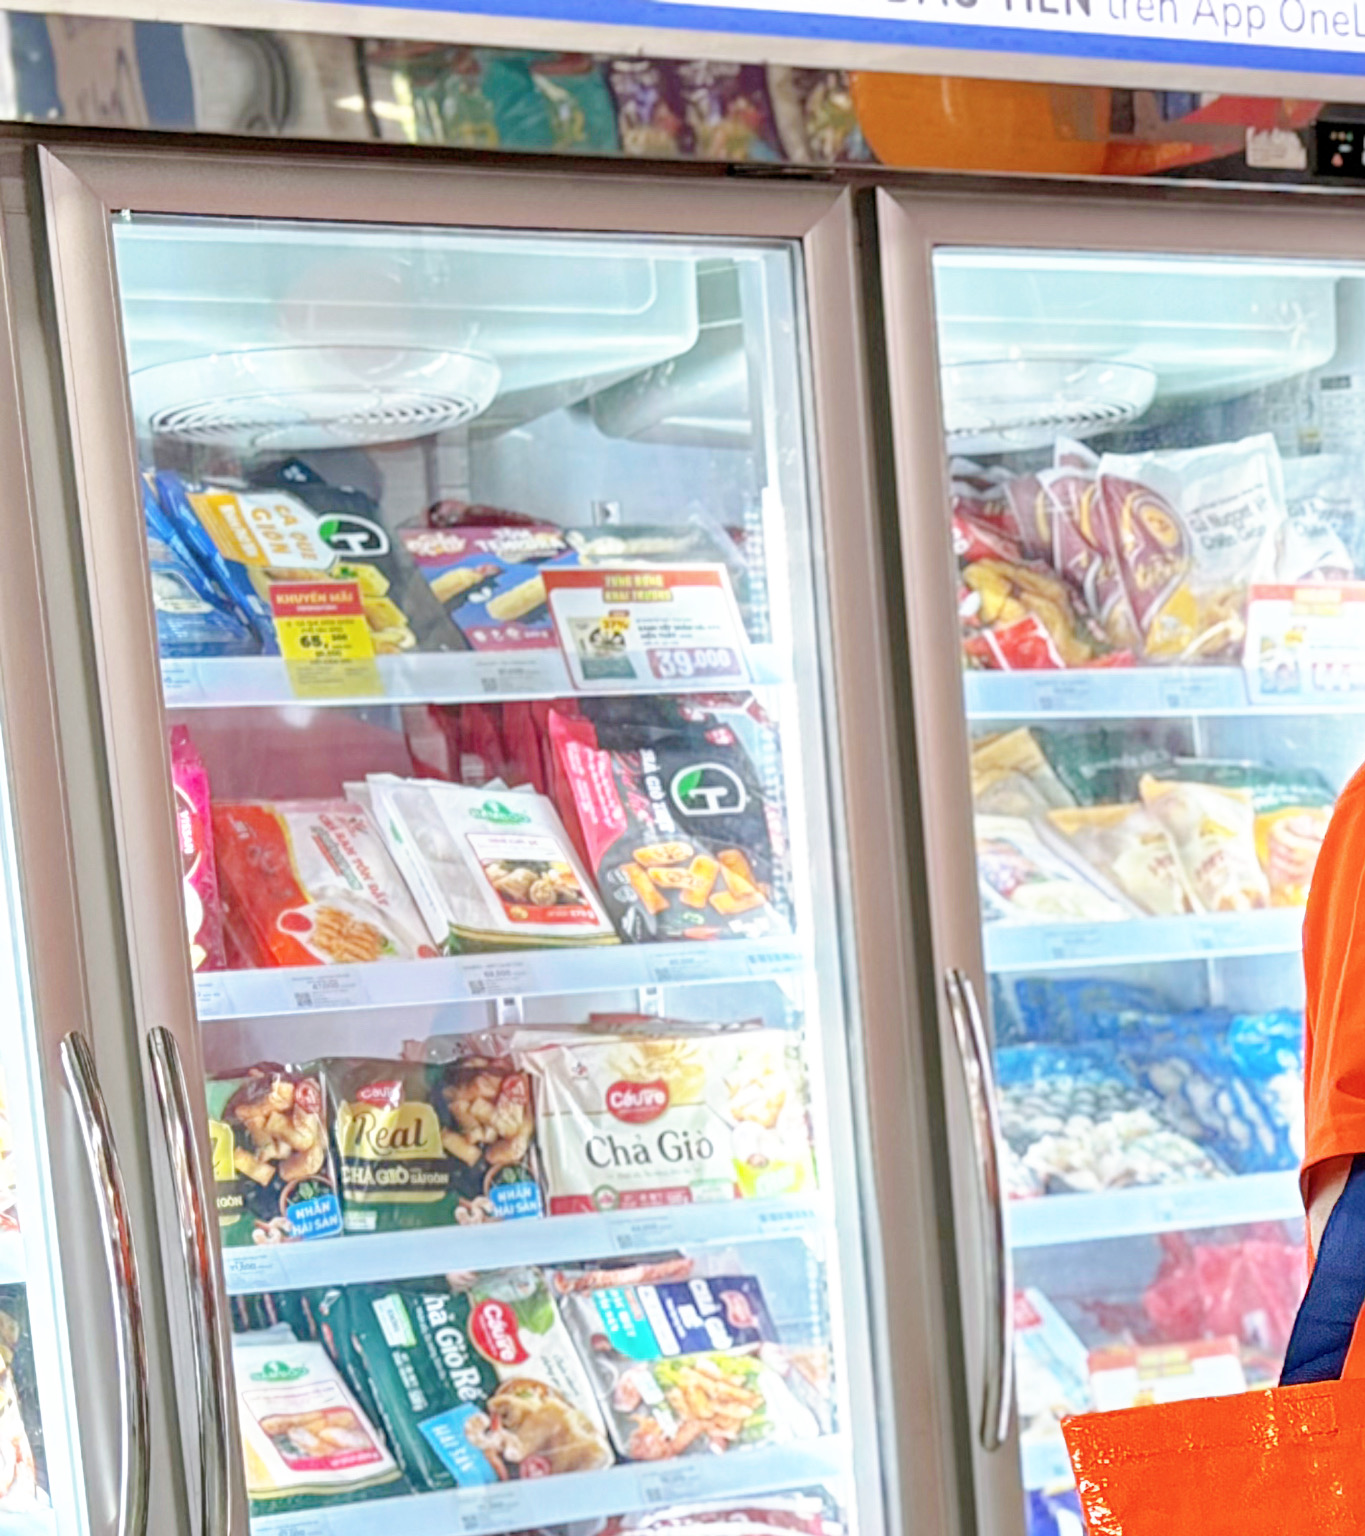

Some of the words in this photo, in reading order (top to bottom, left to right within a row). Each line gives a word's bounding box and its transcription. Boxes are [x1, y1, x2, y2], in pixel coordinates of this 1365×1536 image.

[1194, 0, 1266, 38] App
[354, 1110, 428, 1157] Real
[584, 1129, 652, 1168] Chả
[657, 1129, 714, 1161] Giò
